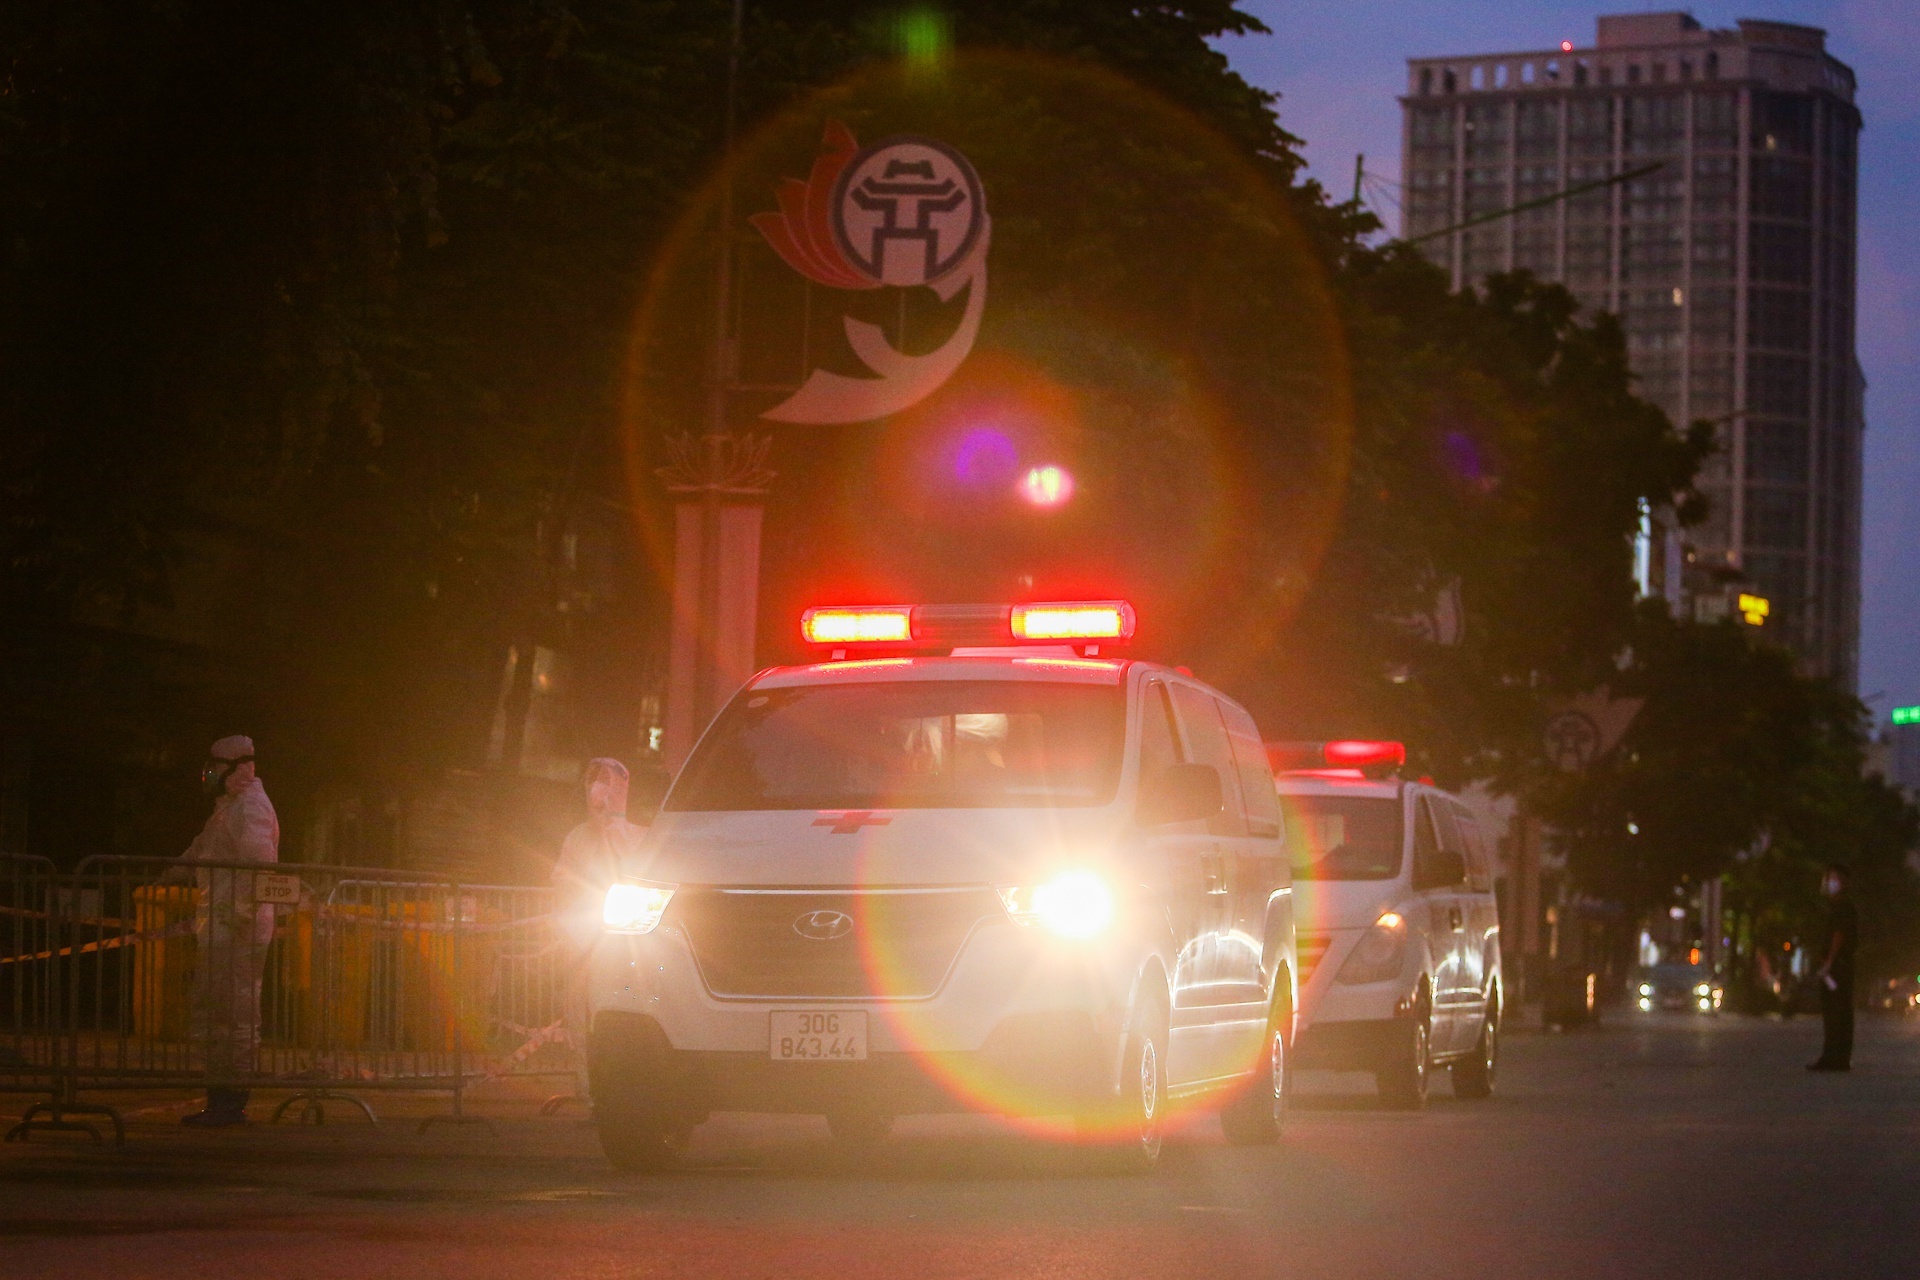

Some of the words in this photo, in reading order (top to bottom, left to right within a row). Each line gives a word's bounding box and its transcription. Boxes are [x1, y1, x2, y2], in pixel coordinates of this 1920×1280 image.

[265, 887, 291, 898] STOP
[799, 1013, 839, 1035] 30G
[780, 1037, 857, 1058] 843.44
